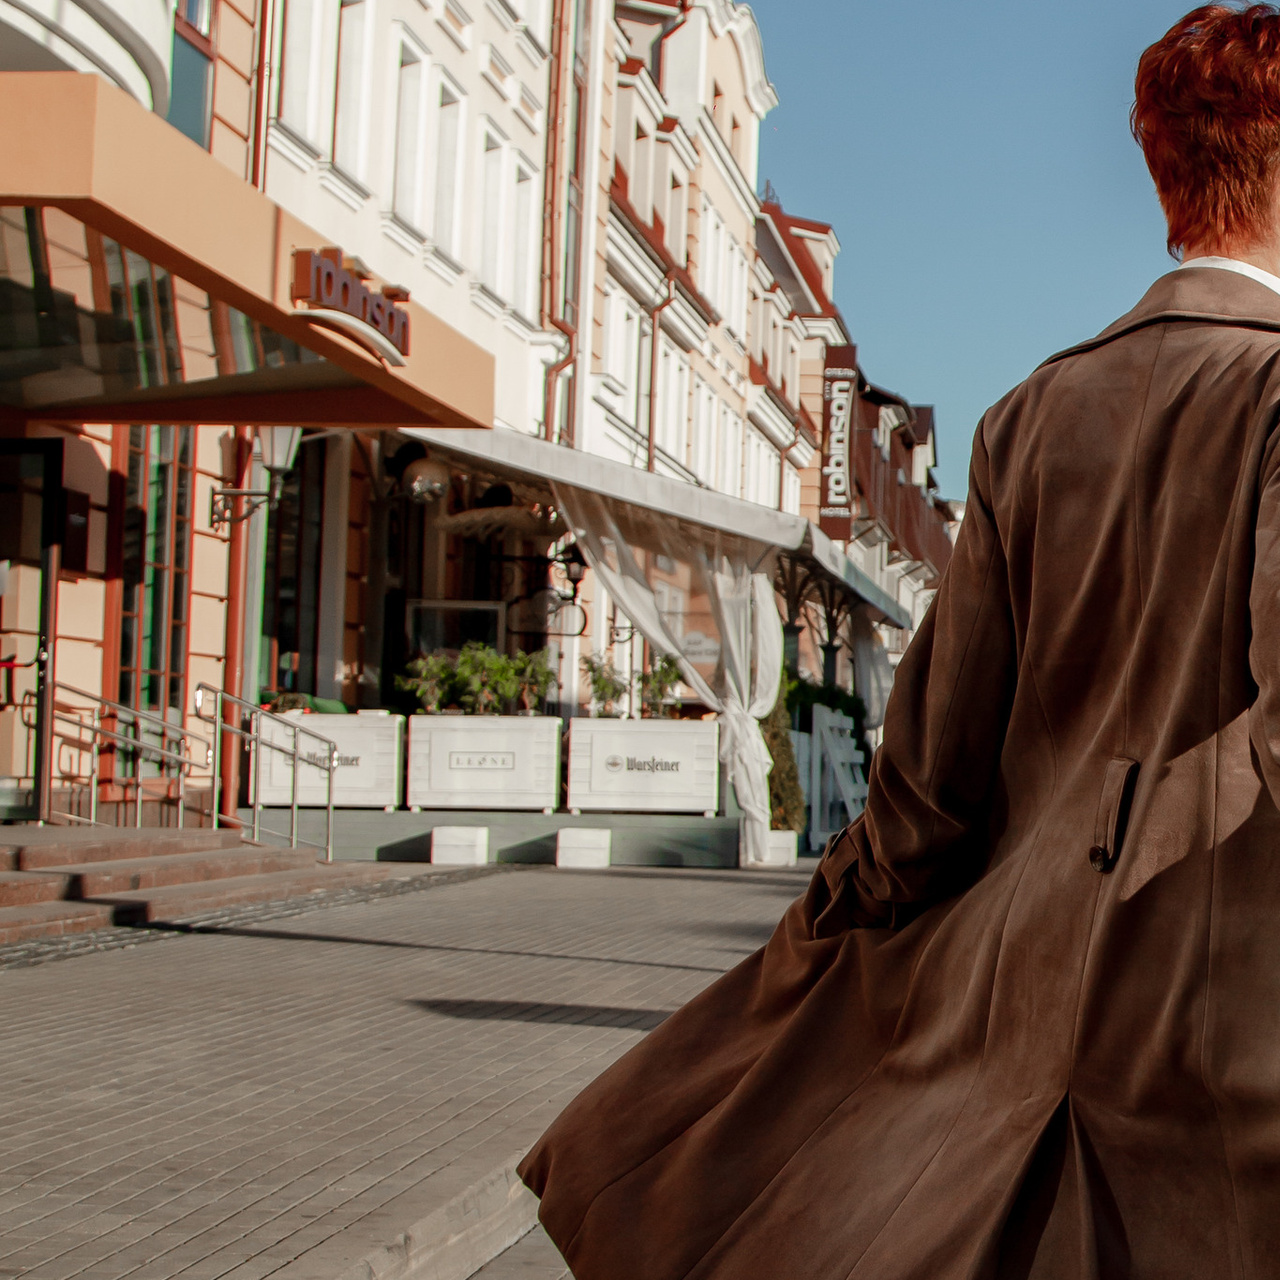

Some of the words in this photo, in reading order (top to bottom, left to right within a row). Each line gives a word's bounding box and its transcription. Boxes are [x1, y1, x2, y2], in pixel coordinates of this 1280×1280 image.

[308, 248, 411, 357] robinson
[822, 380, 851, 506] robinson
[820, 506, 851, 518] HOTEL
[626, 756, 680, 773] Warsteiner
